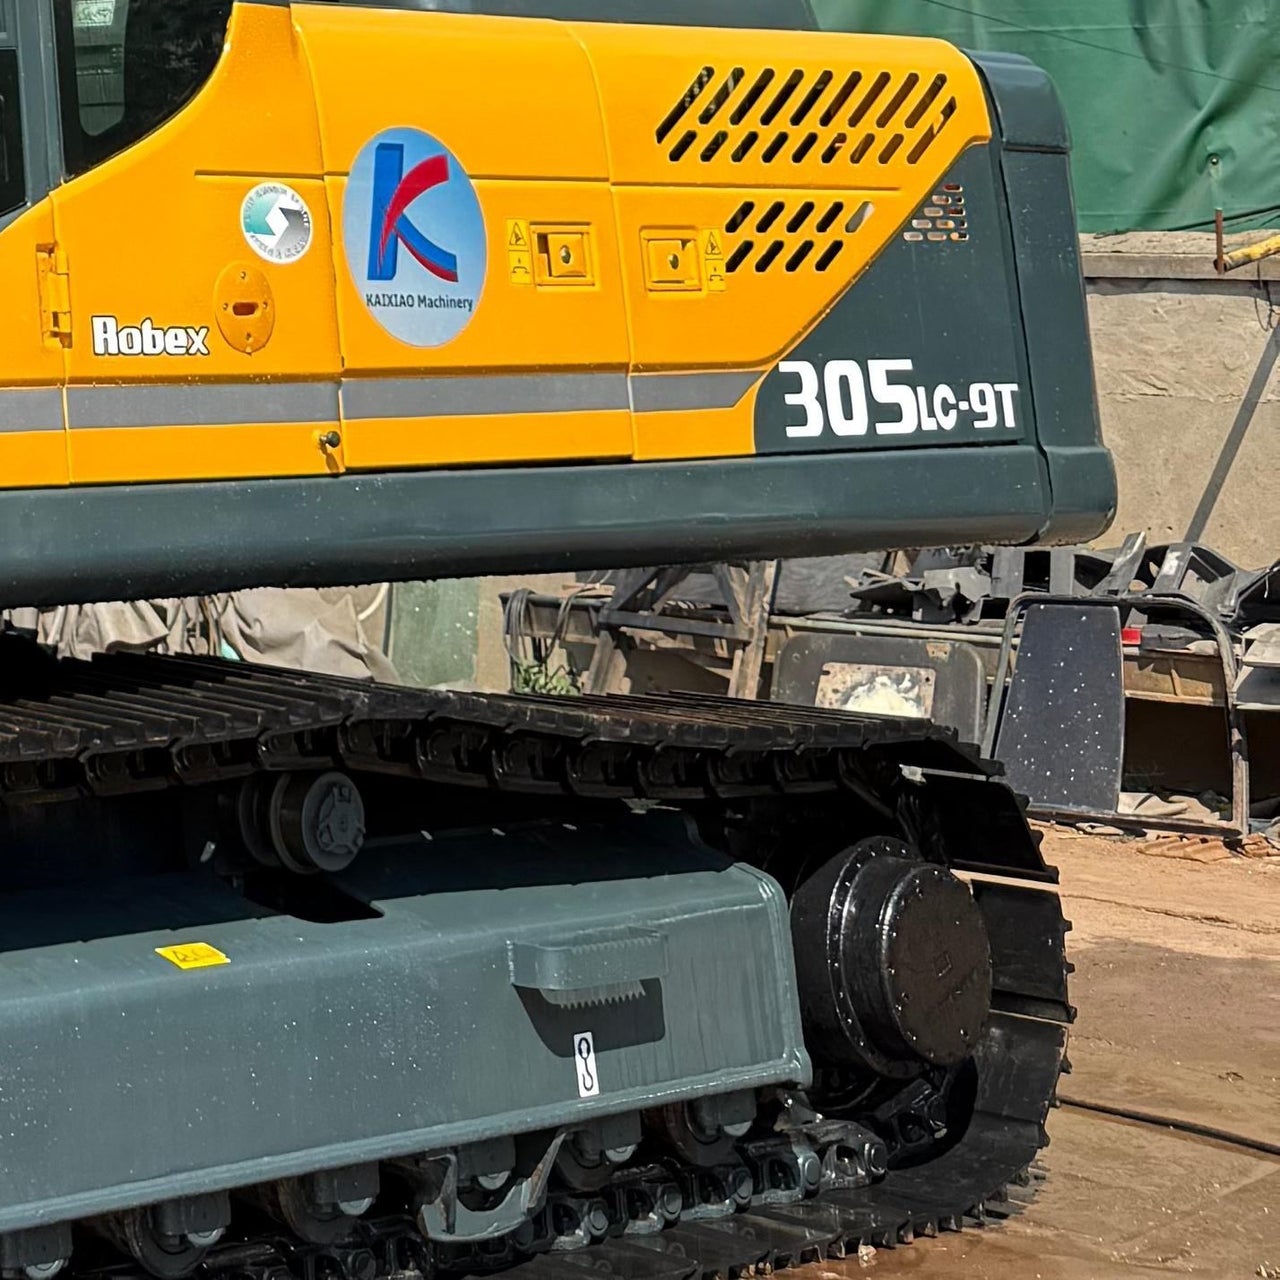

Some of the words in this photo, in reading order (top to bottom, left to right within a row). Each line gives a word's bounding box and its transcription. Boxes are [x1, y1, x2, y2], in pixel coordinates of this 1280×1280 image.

[366, 293, 415, 308] KAIXIAO
[417, 294, 473, 312] Machinery
[91, 315, 210, 355] Robex
